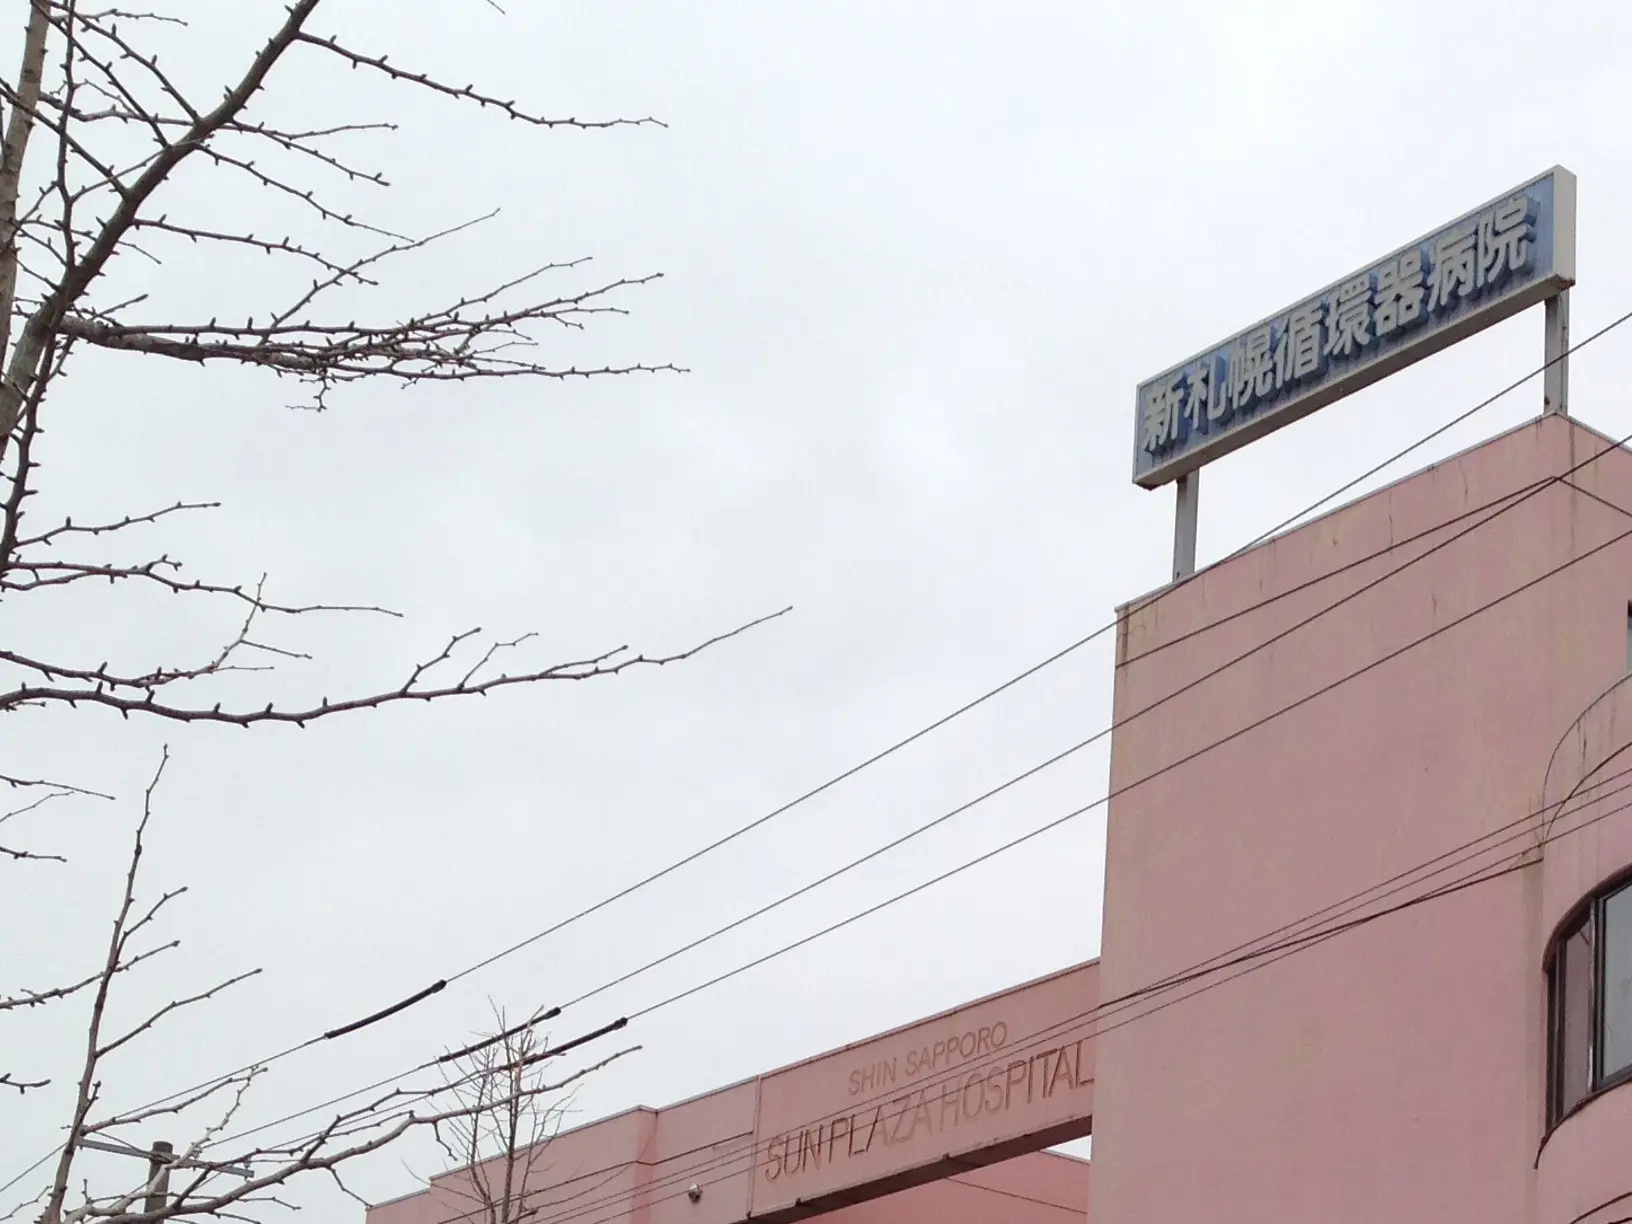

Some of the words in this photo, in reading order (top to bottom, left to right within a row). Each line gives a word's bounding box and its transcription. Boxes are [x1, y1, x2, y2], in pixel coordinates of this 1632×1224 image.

[1141, 193, 1531, 453] 新札幌循環器病院
[849, 1056, 898, 1097] SHIN
[904, 1020, 1009, 1078] SAPPORO
[939, 1041, 1095, 1132] HOSPITAL
